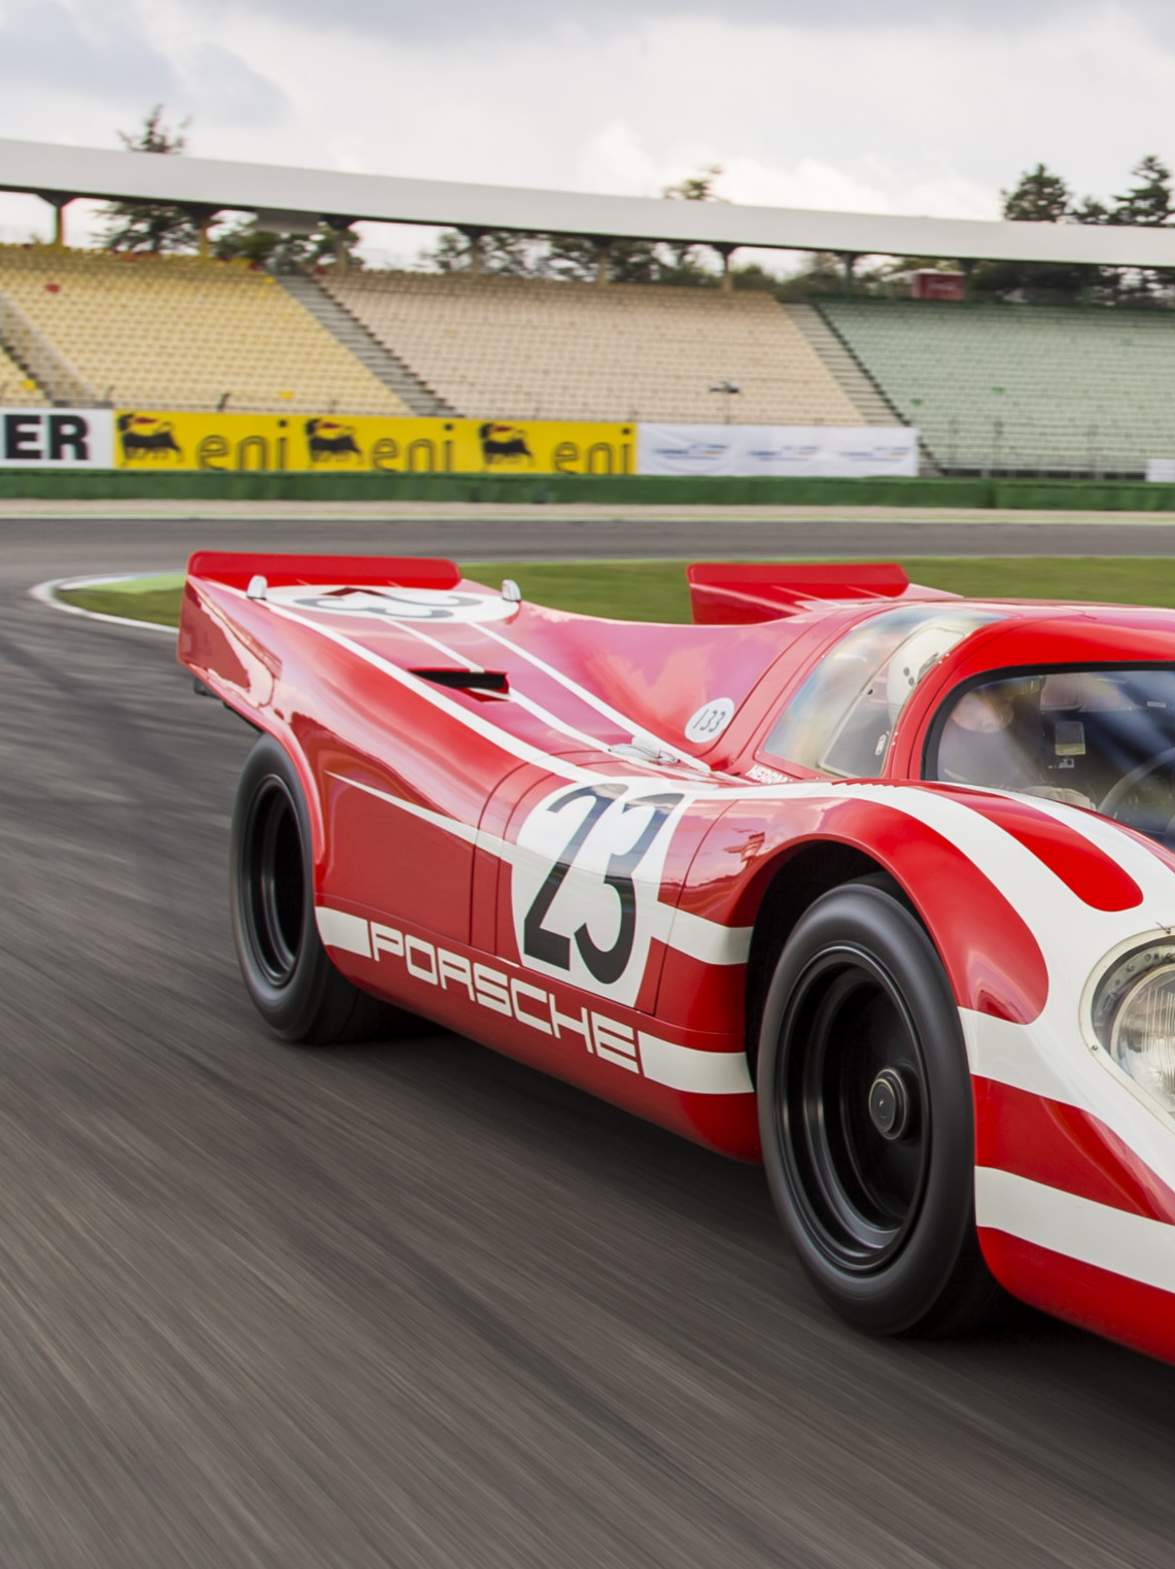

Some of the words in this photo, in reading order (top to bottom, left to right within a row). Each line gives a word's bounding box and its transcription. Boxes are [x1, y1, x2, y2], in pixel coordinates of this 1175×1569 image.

[4, 414, 89, 460] ER
[197, 419, 289, 472] eni
[372, 422, 456, 473] eni
[554, 427, 632, 475] eni
[693, 708, 726, 732] 133
[523, 783, 685, 985] 23
[370, 921, 640, 1075] PORSCHE
